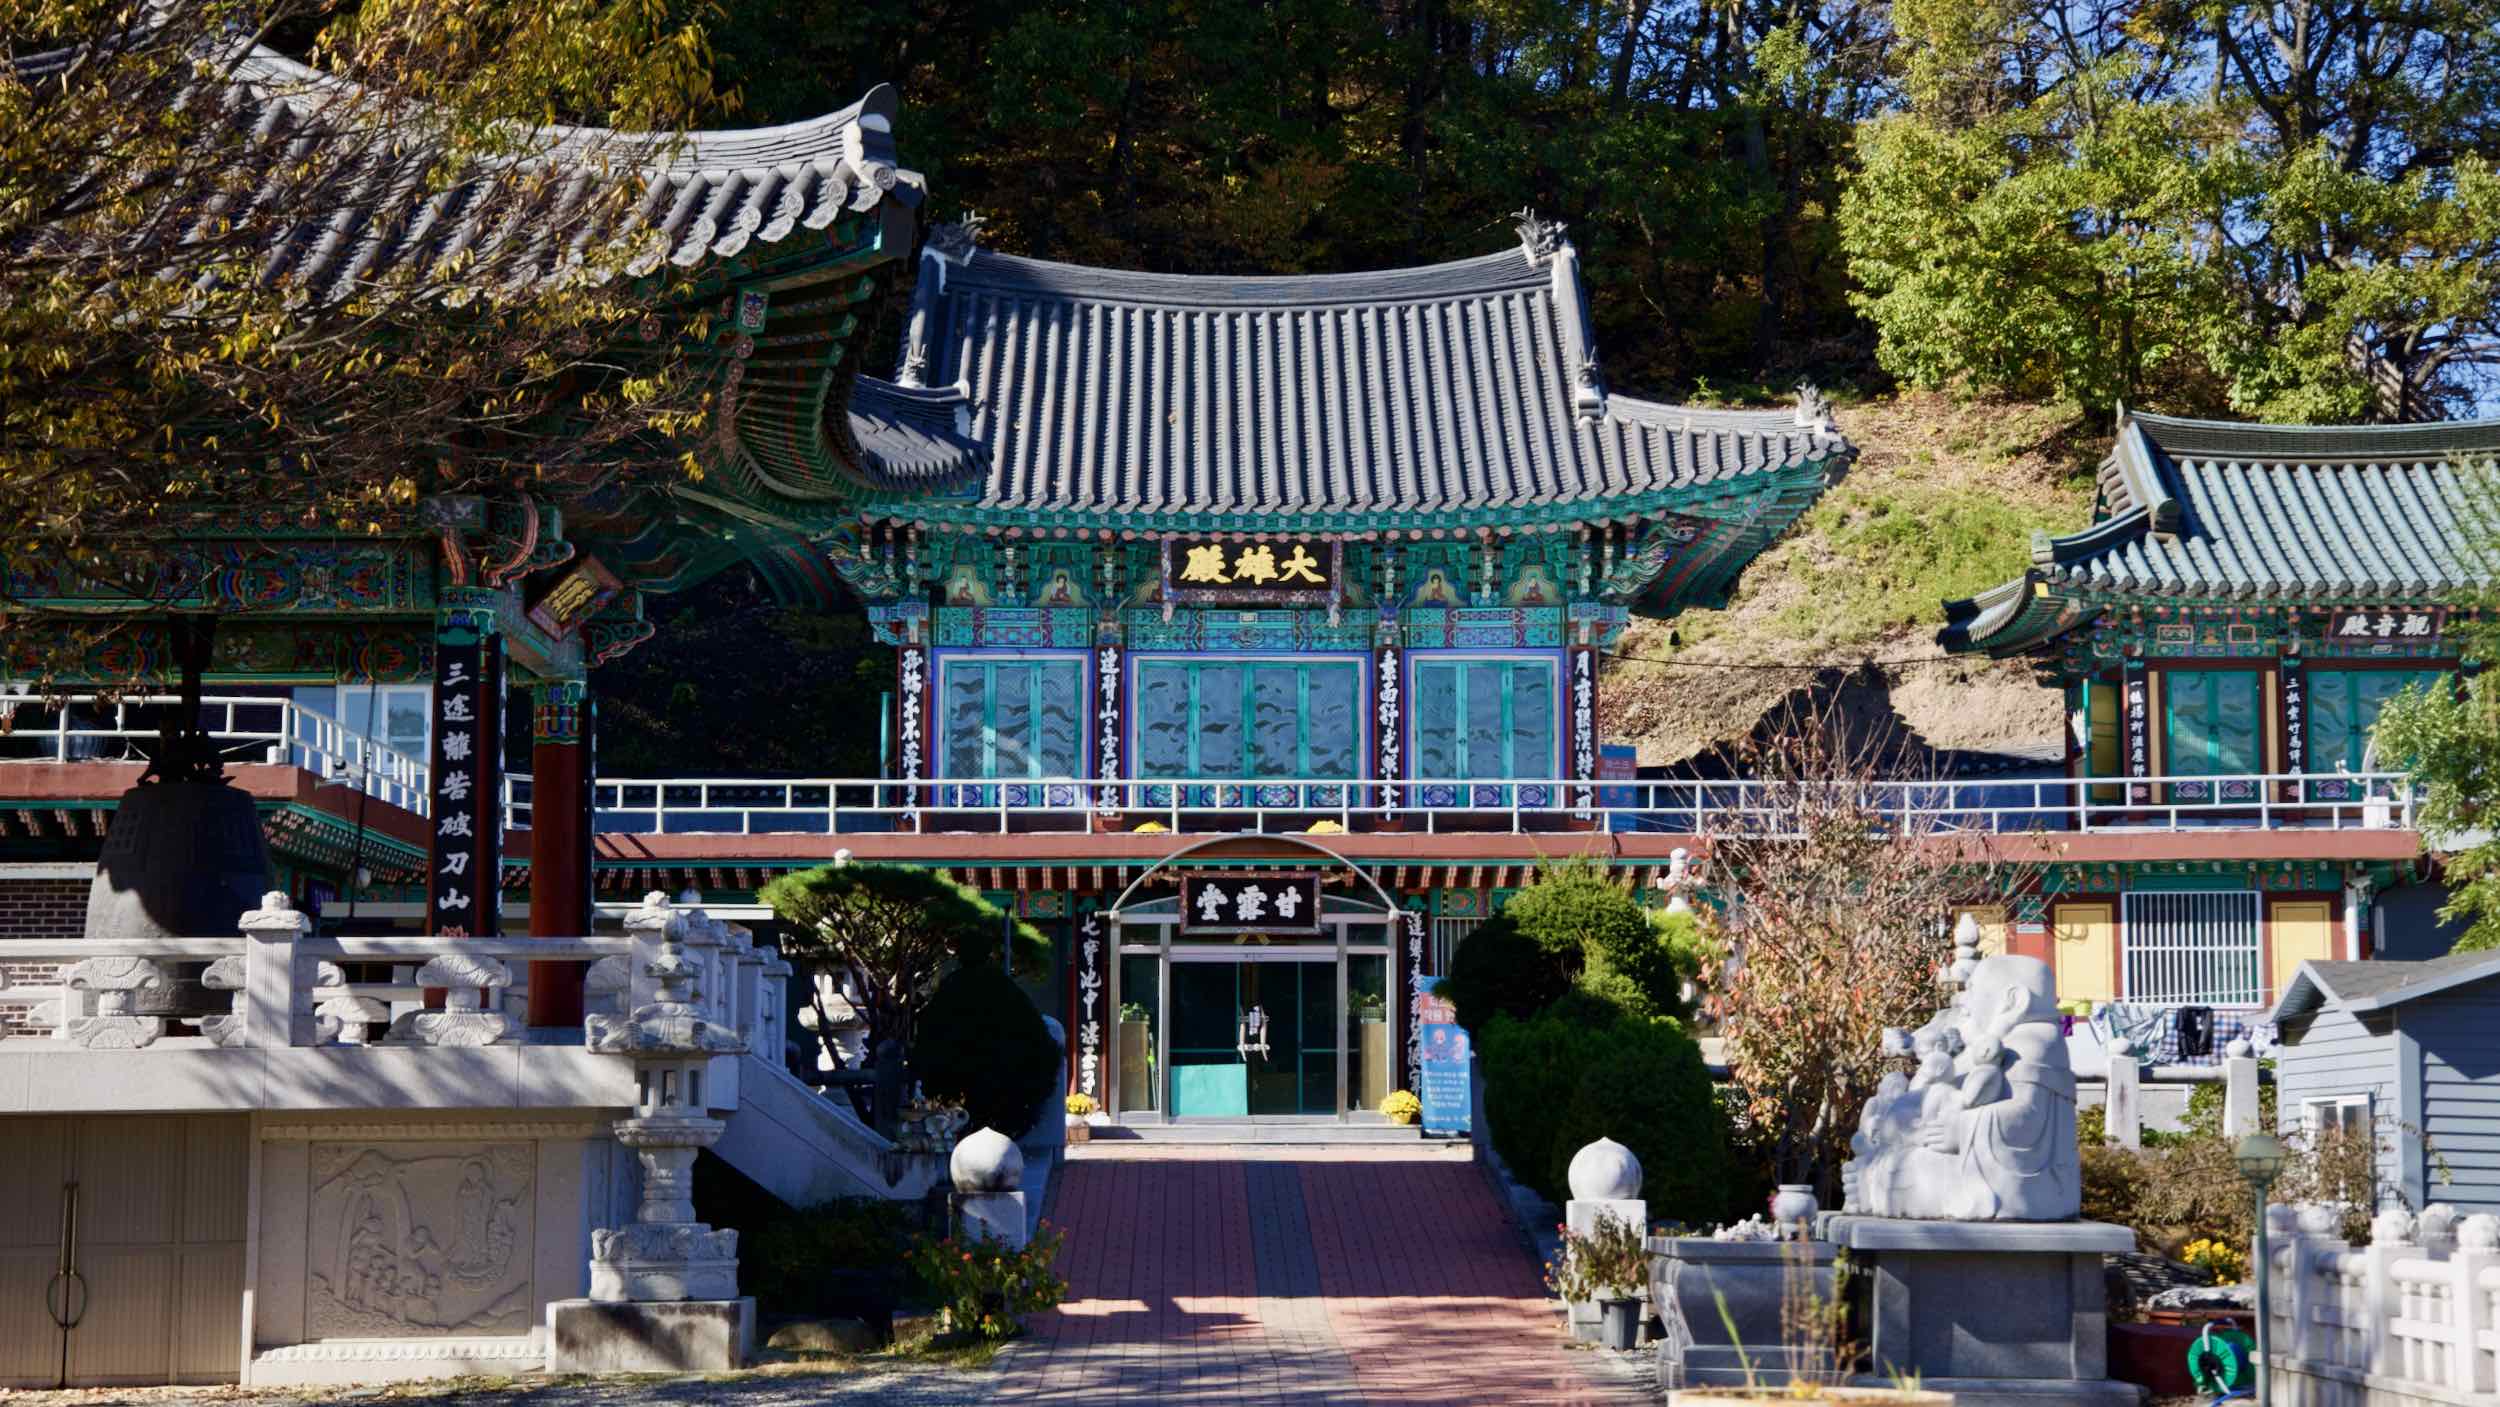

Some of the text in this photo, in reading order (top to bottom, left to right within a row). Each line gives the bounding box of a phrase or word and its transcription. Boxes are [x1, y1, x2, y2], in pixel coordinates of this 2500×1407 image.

[1179, 544, 1326, 585] 大雄殿
[2339, 613, 2431, 637] 觀音殿
